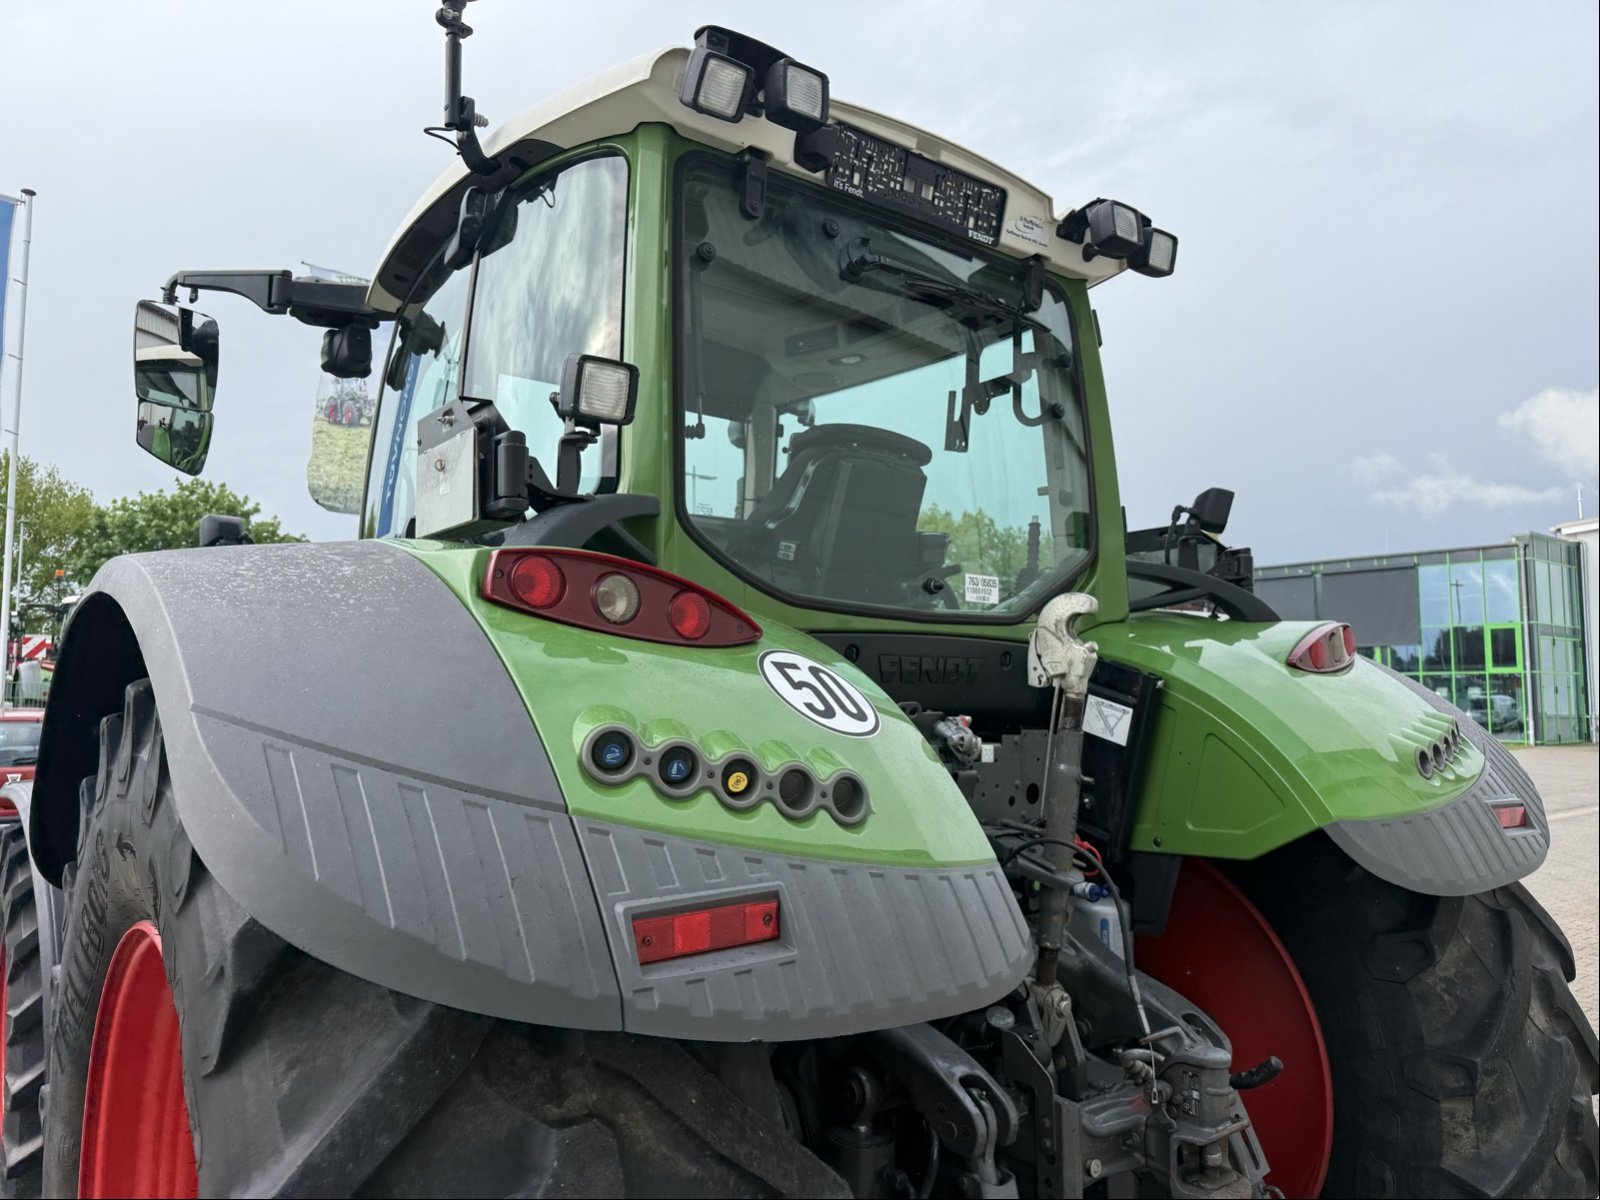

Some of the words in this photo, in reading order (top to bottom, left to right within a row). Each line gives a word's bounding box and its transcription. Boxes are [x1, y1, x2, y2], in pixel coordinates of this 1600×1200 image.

[968, 229, 995, 245] FENDT
[770, 660, 868, 723] 50
[878, 653, 986, 684] FENDT
[54, 827, 111, 1075] TRELLEBORG
